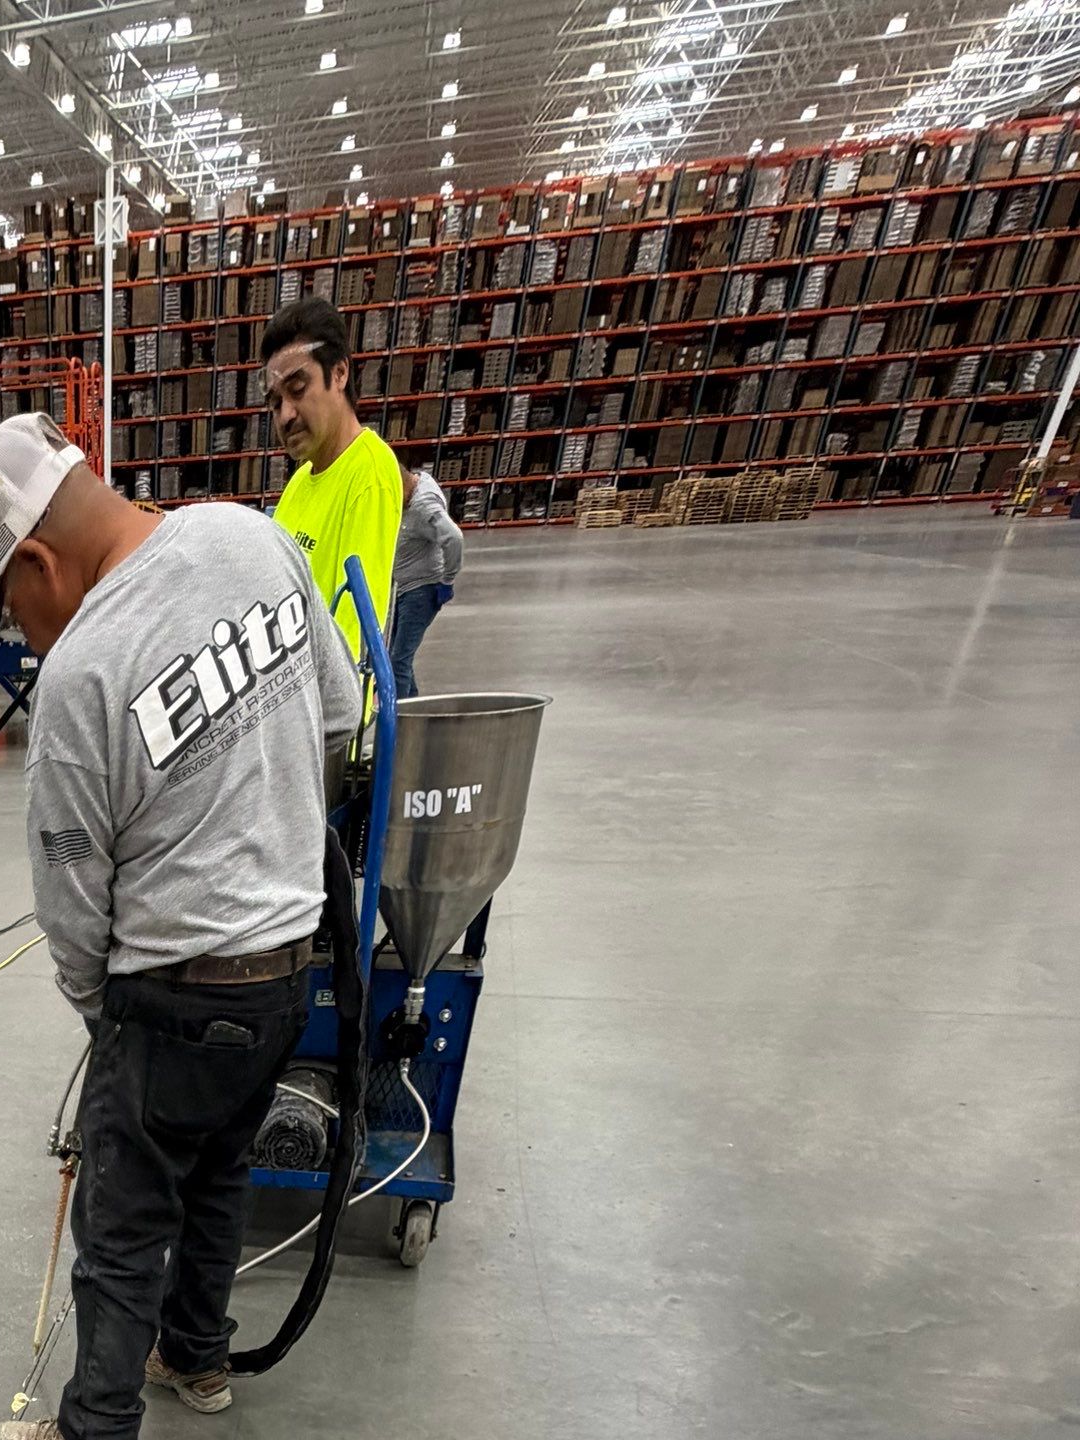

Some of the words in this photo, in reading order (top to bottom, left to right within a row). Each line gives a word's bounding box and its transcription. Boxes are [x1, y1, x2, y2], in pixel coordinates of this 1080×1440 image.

[127, 589, 309, 771] Elite
[174, 705, 244, 768] NCRETE
[403, 789, 442, 818] ISO
[446, 784, 483, 814] "A"
